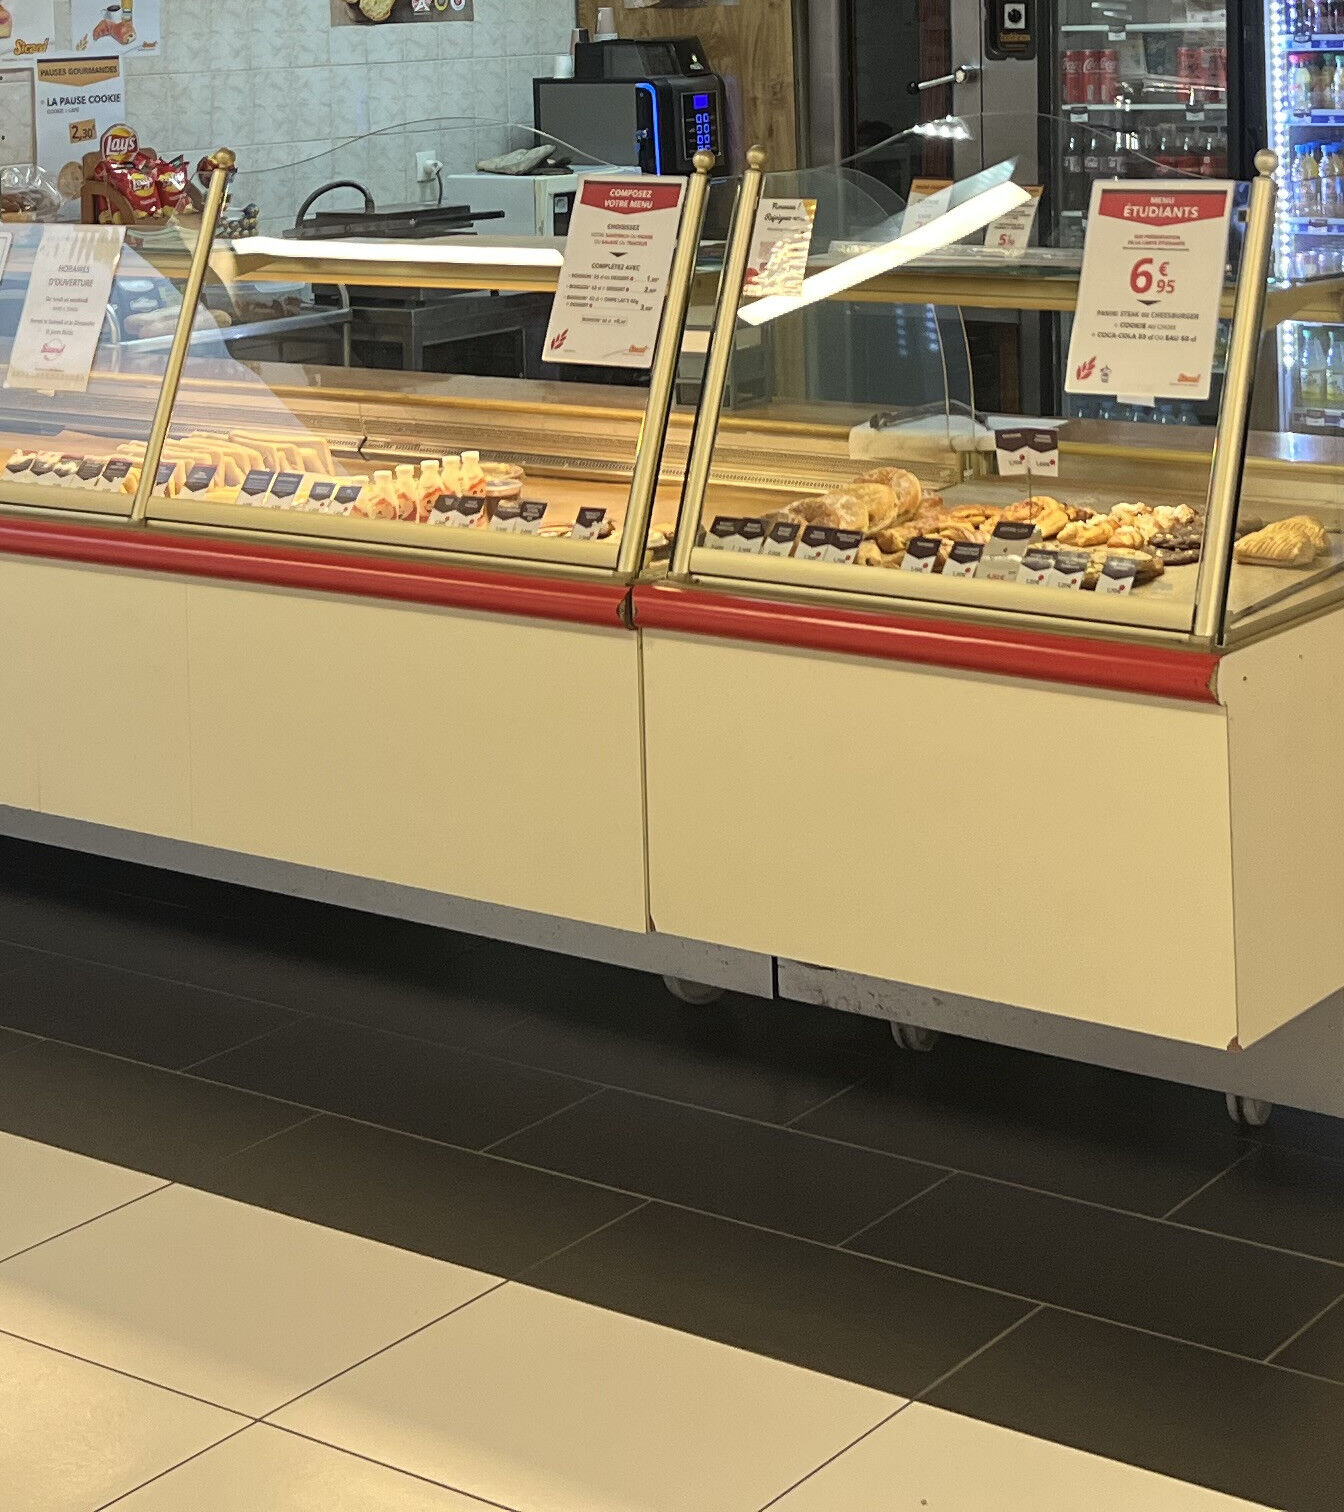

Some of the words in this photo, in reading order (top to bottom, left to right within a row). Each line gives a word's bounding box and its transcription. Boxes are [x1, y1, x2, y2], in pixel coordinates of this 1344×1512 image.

[13, 37, 50, 56] Sicard
[46, 96, 58, 107] LA
[59, 95, 87, 106] PAUSE
[88, 93, 121, 104] COOKIE
[609, 188, 653, 198] COMPOSEZ
[604, 199, 630, 208] VOTRE
[629, 200, 654, 209] MENU
[1123, 203, 1200, 219] ÉTUDIANTS
